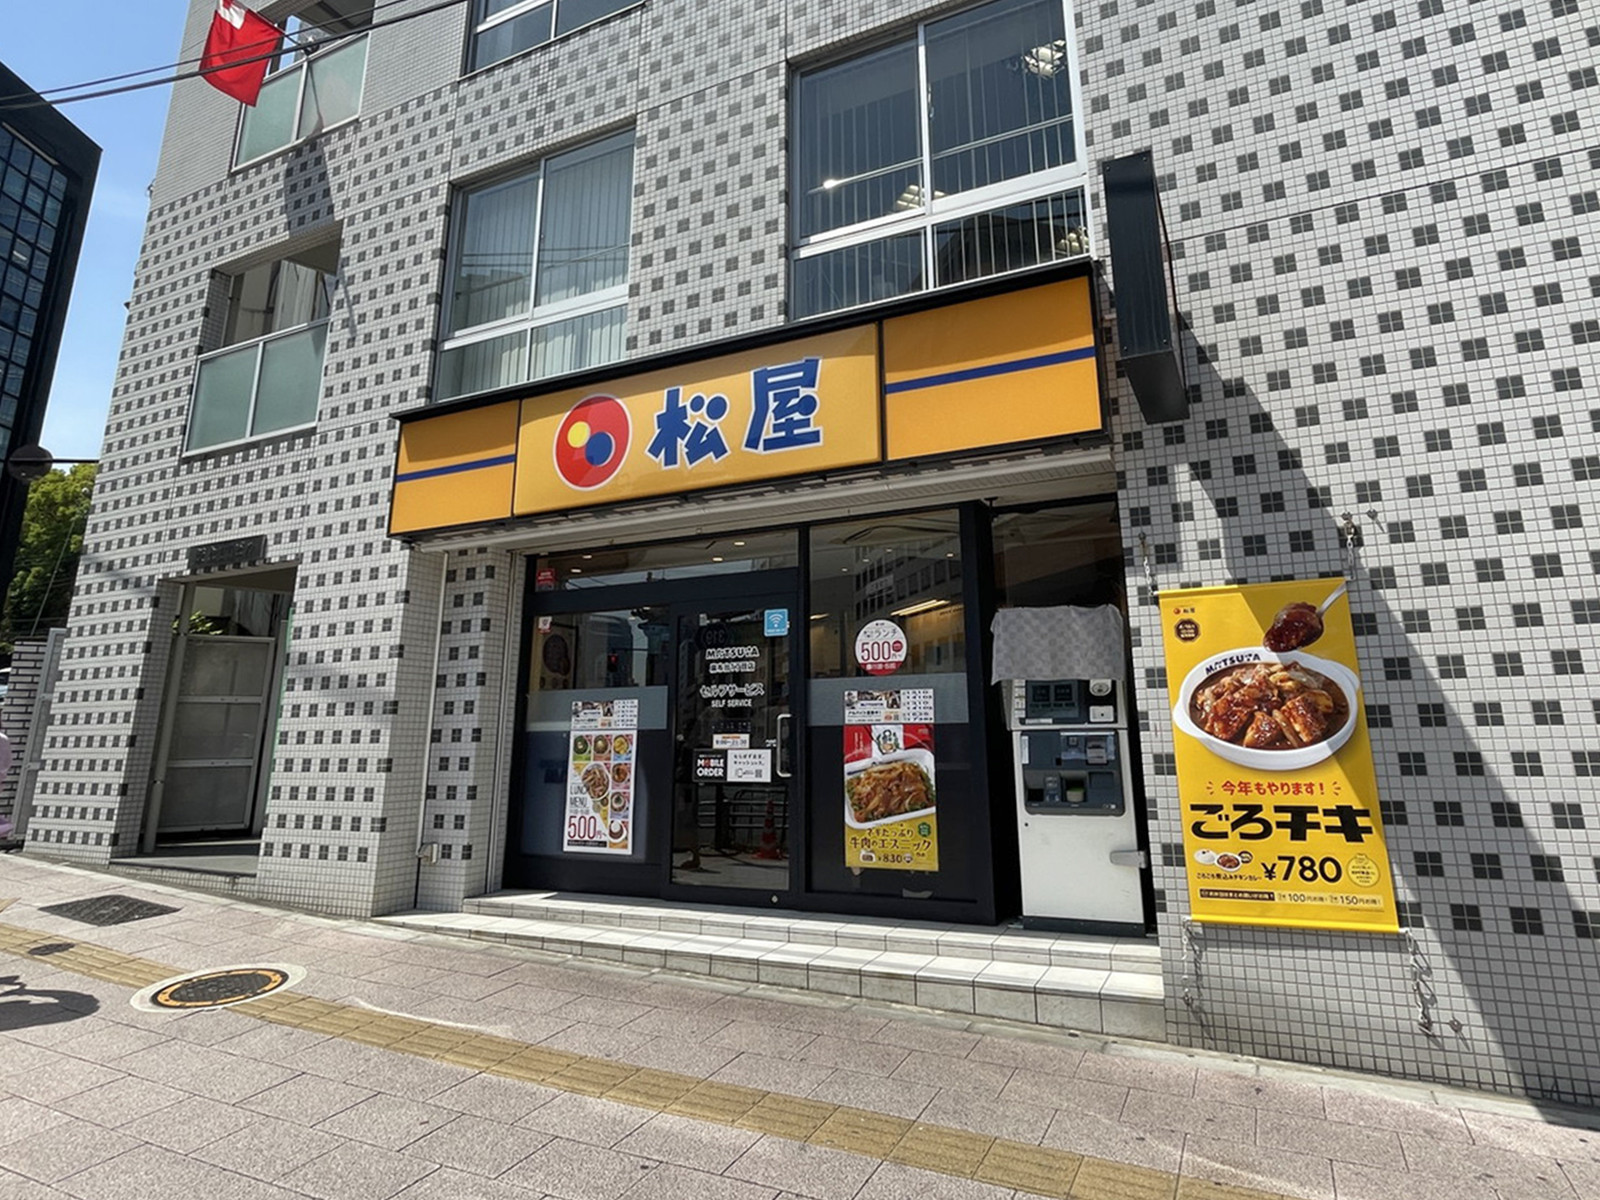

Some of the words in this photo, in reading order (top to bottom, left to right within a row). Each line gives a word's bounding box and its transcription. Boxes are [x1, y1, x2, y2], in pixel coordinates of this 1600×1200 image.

[646, 357, 822, 469] 松屋
[706, 646, 760, 660] MATSUYA
[1205, 653, 1261, 675] MATSUYA
[700, 683, 765, 698] セルフサービス
[711, 699, 726, 707] SELF
[727, 699, 752, 707] SERVICE
[697, 758, 724, 767] MOBILE
[697, 767, 724, 776] ORDER
[1222, 781, 1325, 796] 今年もやります！
[569, 796, 588, 808] MENU
[1190, 804, 1373, 843] ごろチキ
[866, 825, 914, 837] ネギたっぷり
[850, 837, 931, 851] 牛肉のエスニック
[1261, 856, 1342, 883] ¥780
